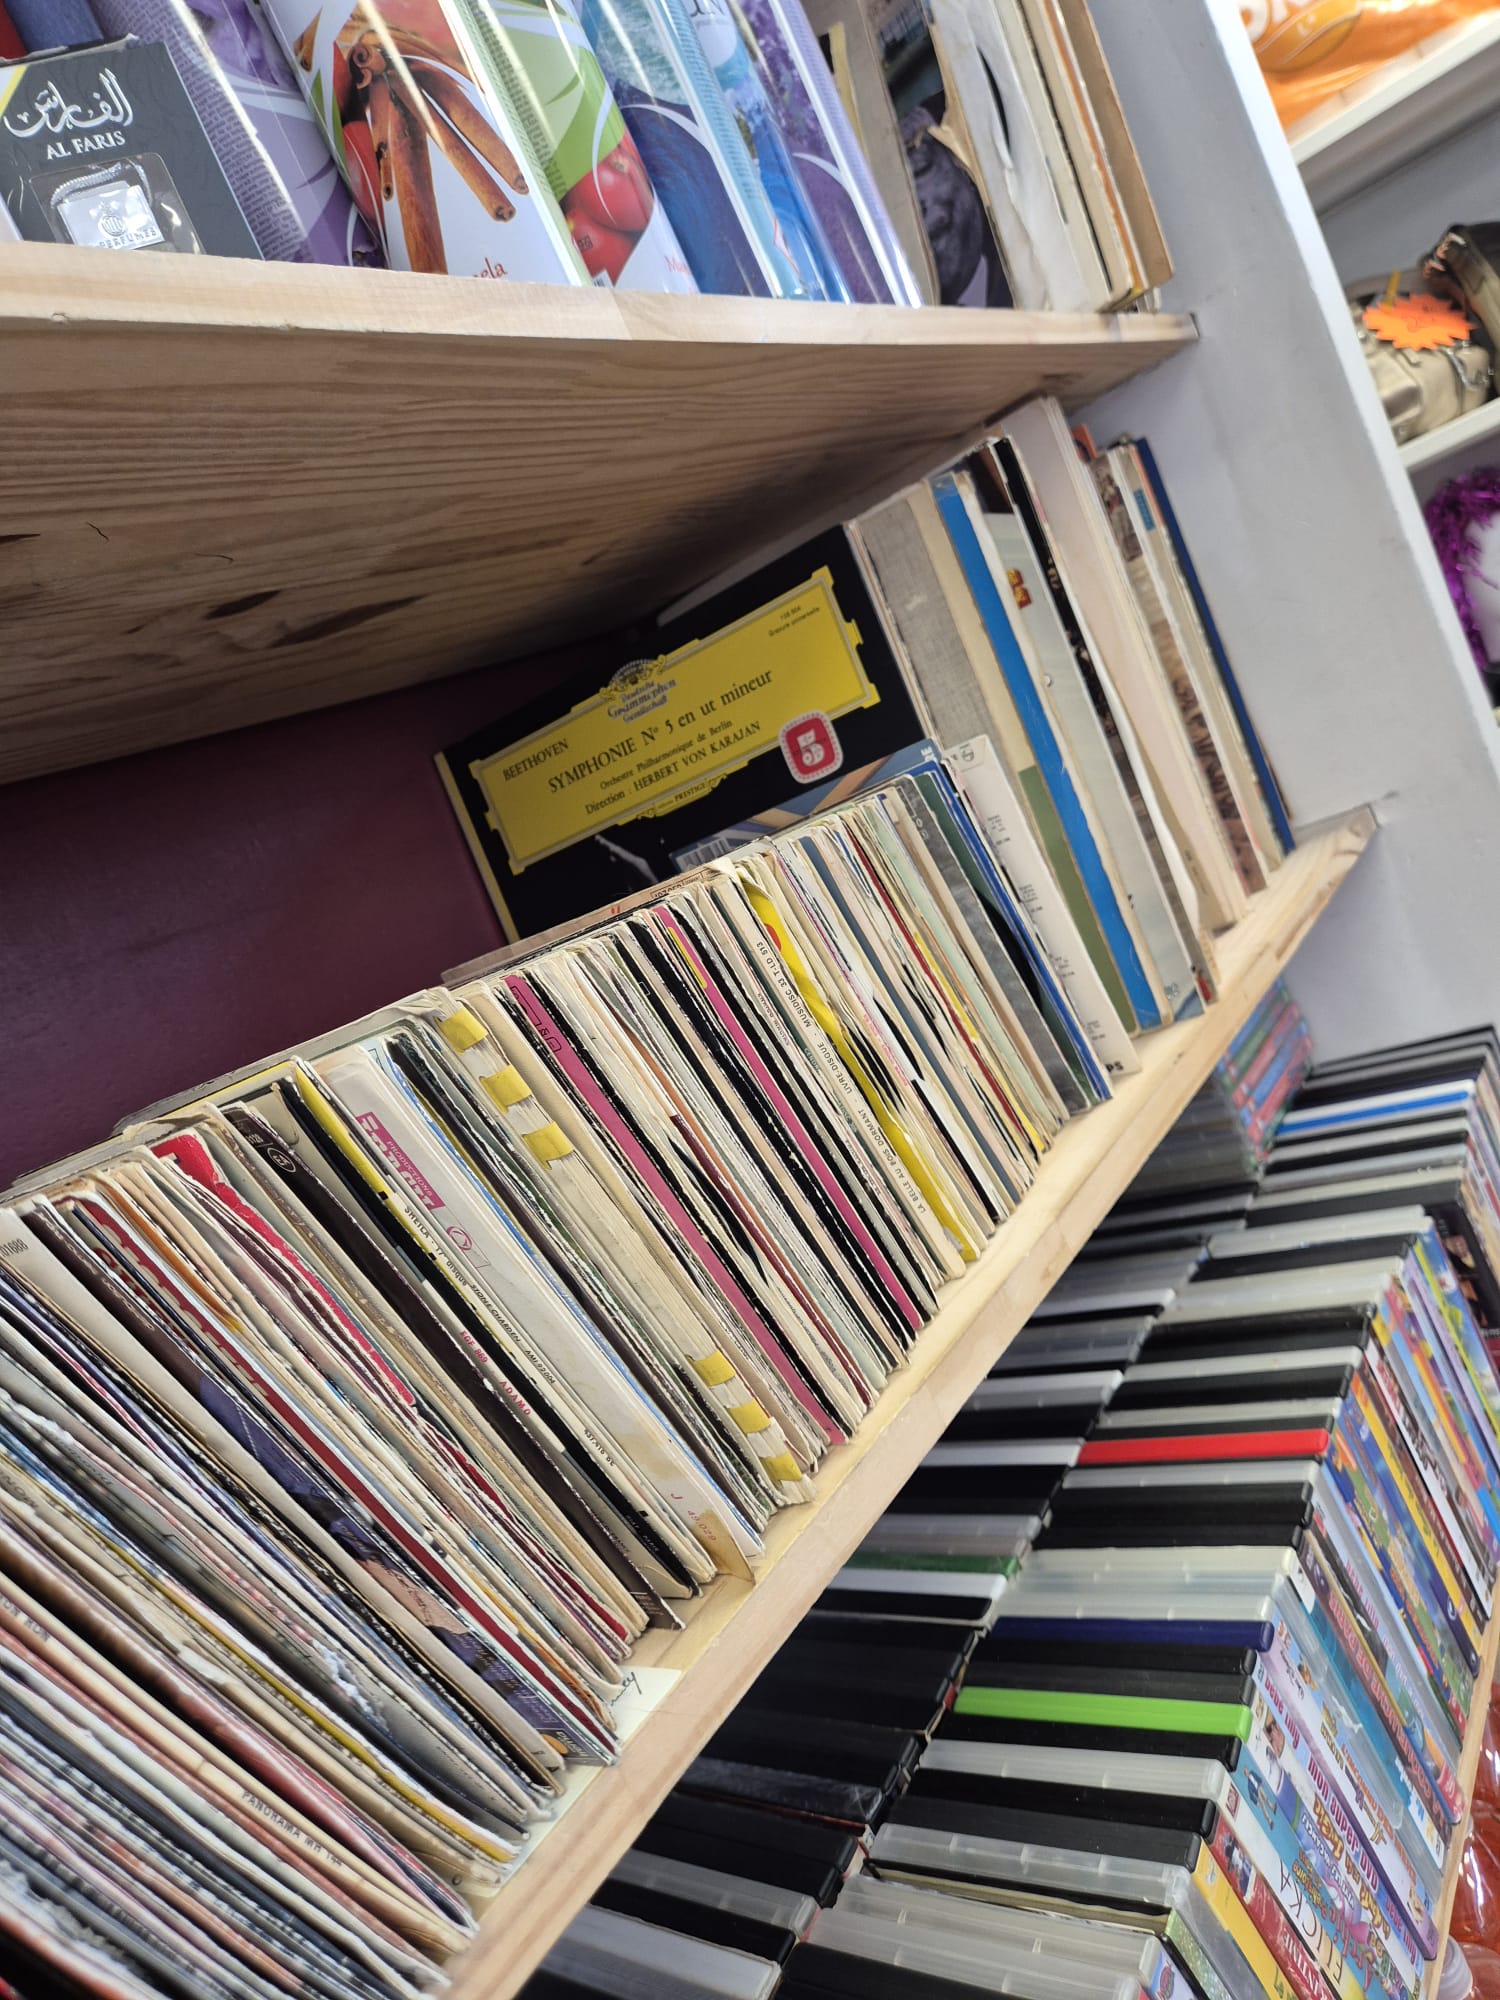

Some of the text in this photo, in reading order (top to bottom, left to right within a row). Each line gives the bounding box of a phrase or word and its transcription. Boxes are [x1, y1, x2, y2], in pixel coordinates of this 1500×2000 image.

[46, 130, 126, 160] AL FARIS
[546, 737, 638, 793] SYMPHONIE
[663, 719, 675, 734] 5
[676, 712, 696, 728] en
[698, 700, 717, 716] ut
[718, 671, 774, 706] mineur
[501, 738, 569, 781] BEETHOVEN
[584, 788, 626, 815] Direction
[632, 762, 680, 792] HERBERT
[681, 748, 708, 767] VON
[708, 721, 762, 754] KARAJAN
[598, 718, 733, 789] Orchestre Philharmonique de Berlin
[673, 782, 706, 801] PRESTIGE
[755, 940, 768, 955] 513
[765, 956, 780, 976] T-LD
[777, 976, 787, 987] 33
[784, 987, 812, 1028] MUSIDISC
[817, 1041, 852, 1094] LIVRE-DISQUE
[857, 1107, 884, 1146] DORMANT
[384, 1139, 435, 1197] PRODUCTIONS
[894, 1167, 905, 1179] AU
[902, 1180, 918, 1201] BELLE
[916, 1202, 926, 1213] LA
[403, 1206, 431, 1238] SHEILA
[491, 1307, 521, 1343] CHARDEN
[458, 1329, 532, 1417] EGF 869 ADAMO
[1328, 1588, 1357, 1655] PARIS
[1356, 1641, 1371, 1682] DE
[240, 1790, 302, 1838] PANORAMA
[1308, 1755, 1329, 1801] mon
[1329, 1796, 1356, 1852] super
[1358, 1849, 1379, 1892] DVD
[1301, 1810, 1330, 1870] VACANCES
[1280, 1859, 1342, 1984] FLICKA
